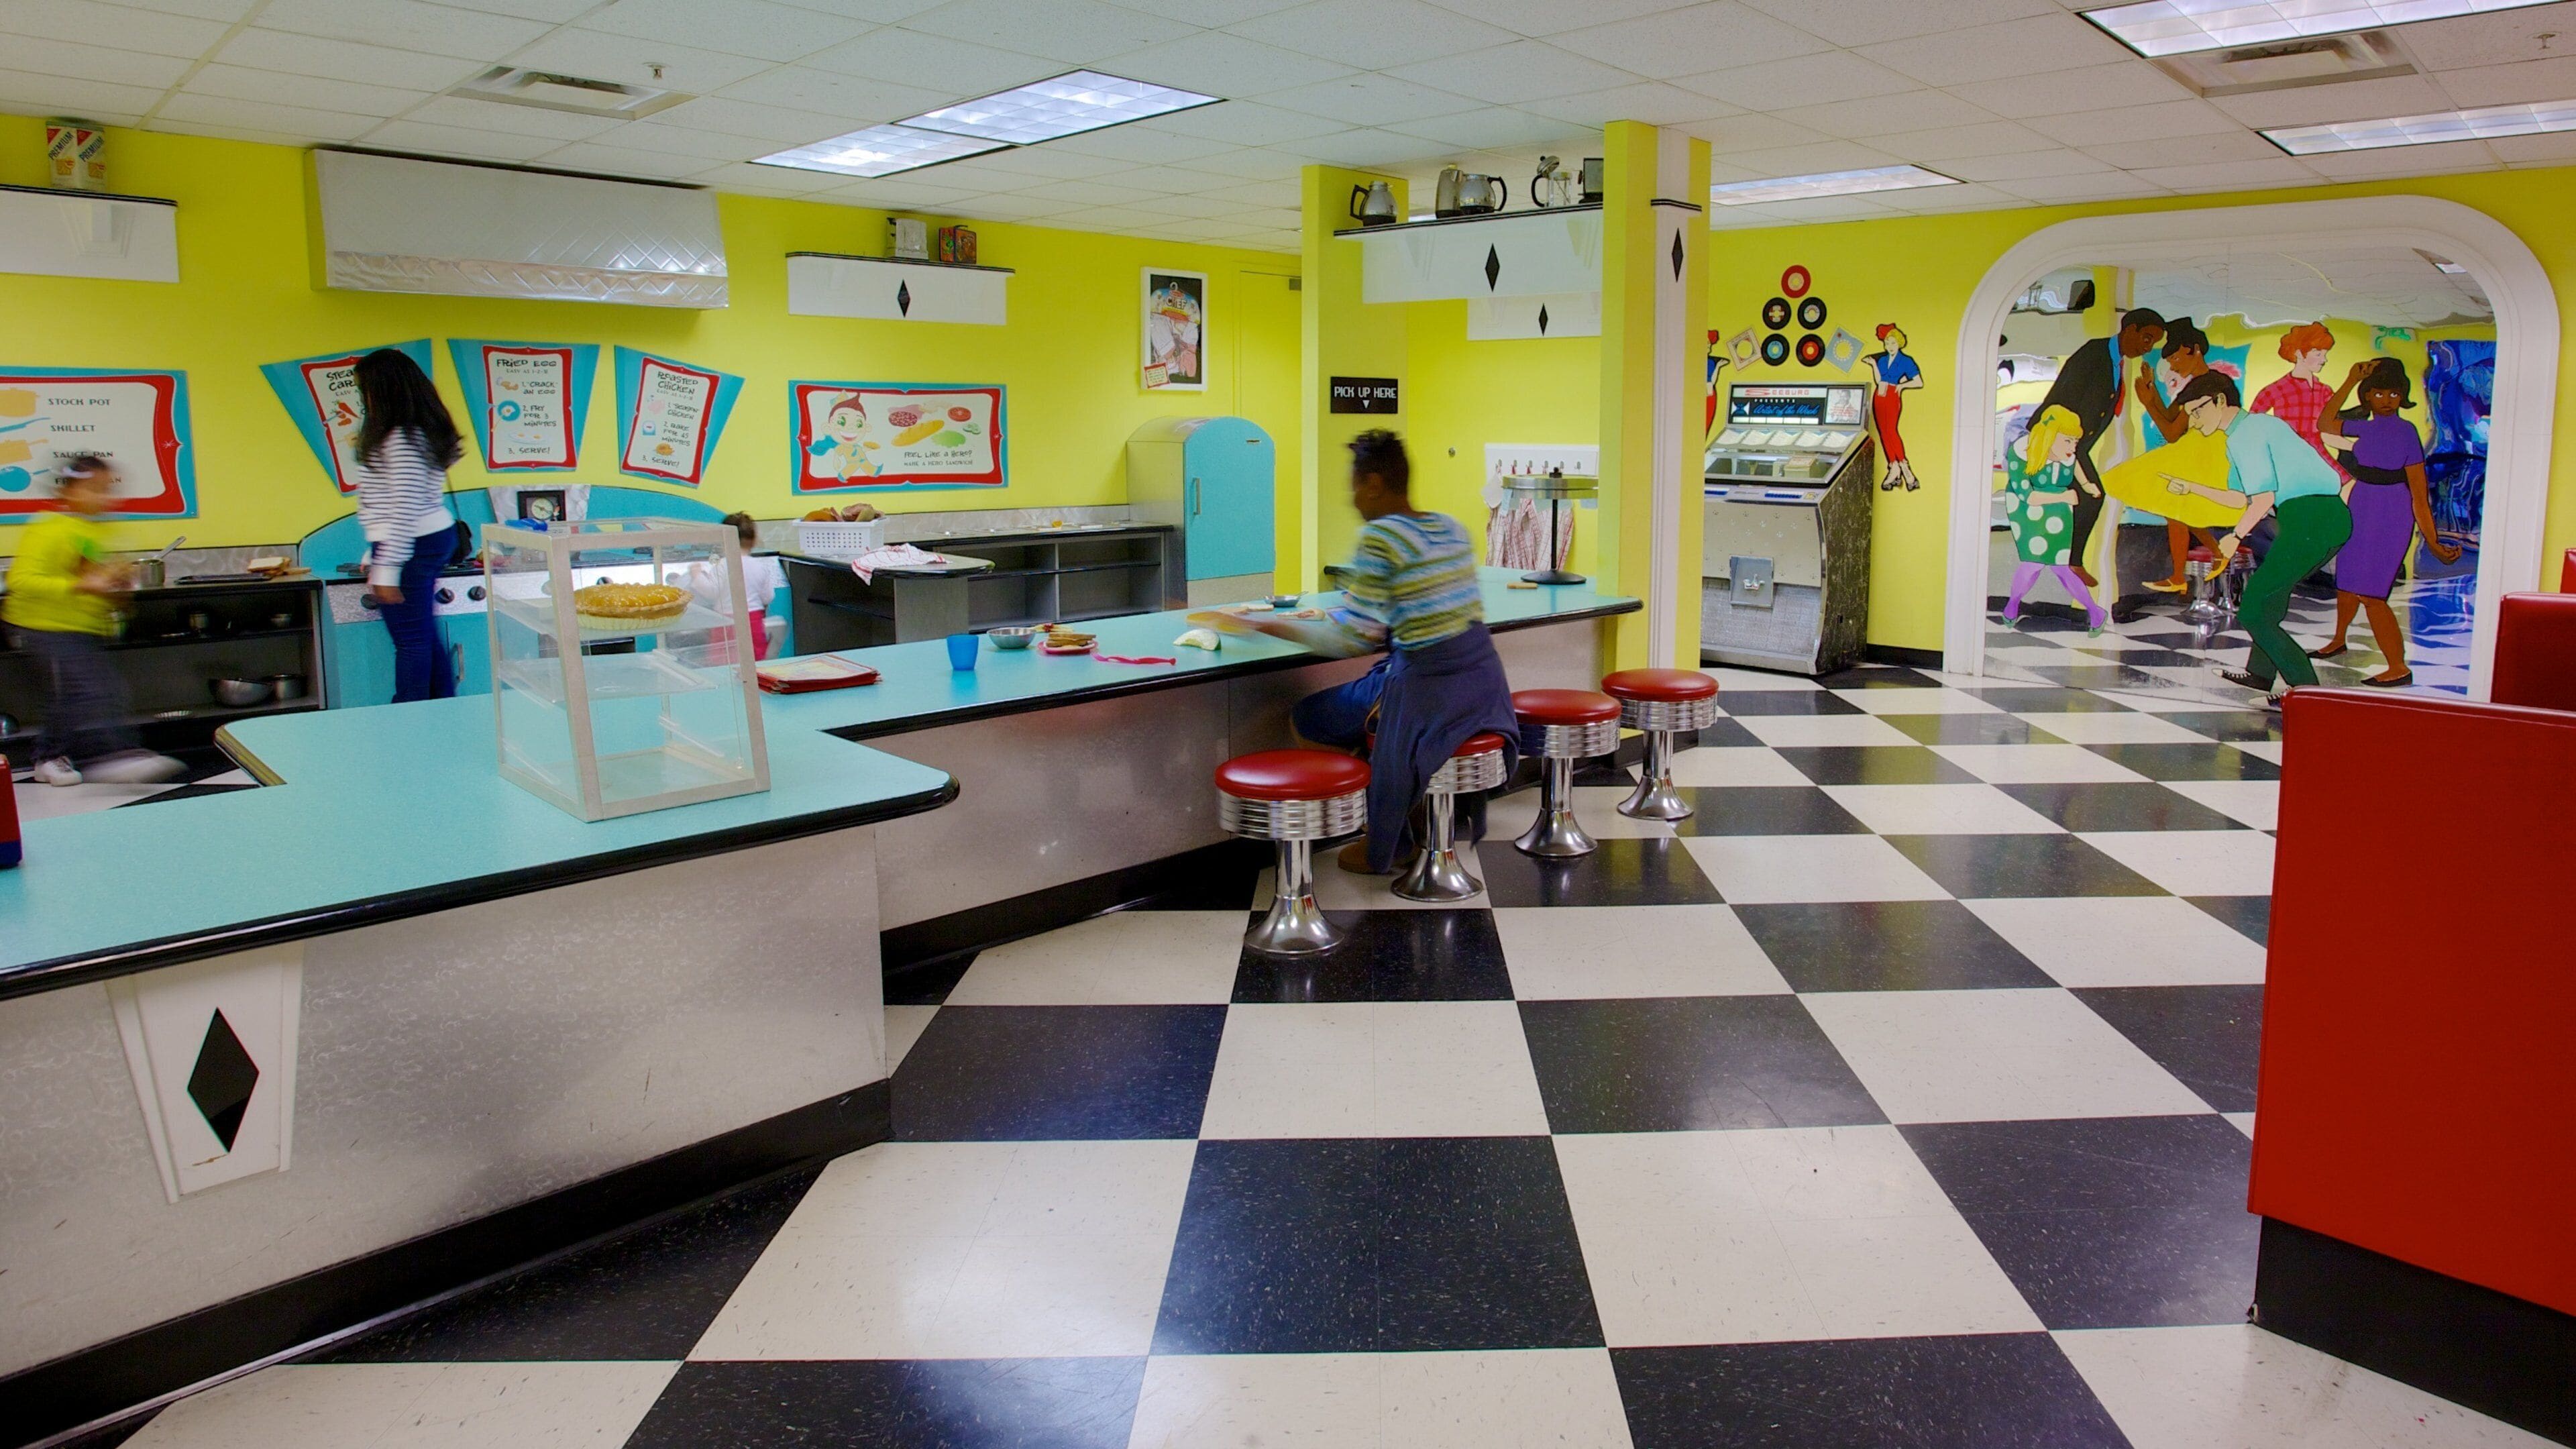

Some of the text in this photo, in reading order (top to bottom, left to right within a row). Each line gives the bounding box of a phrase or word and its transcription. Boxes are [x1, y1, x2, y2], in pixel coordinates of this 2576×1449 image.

[48, 131, 74, 160] PREMIUM
[78, 136, 104, 162] PREMIUM
[1167, 296, 1187, 309] CHEF
[326, 369, 354, 381] STEA
[657, 371, 698, 385] ROASTED
[657, 380, 695, 394] CHICKEN
[1334, 386, 1397, 399] PICK UP HERE
[1745, 388, 1810, 396] SEEBURG
[1753, 404, 1776, 414] Artist
[1796, 404, 1821, 415] Week
[925, 450, 941, 458] LIKE
[951, 449, 973, 458] HERO?
